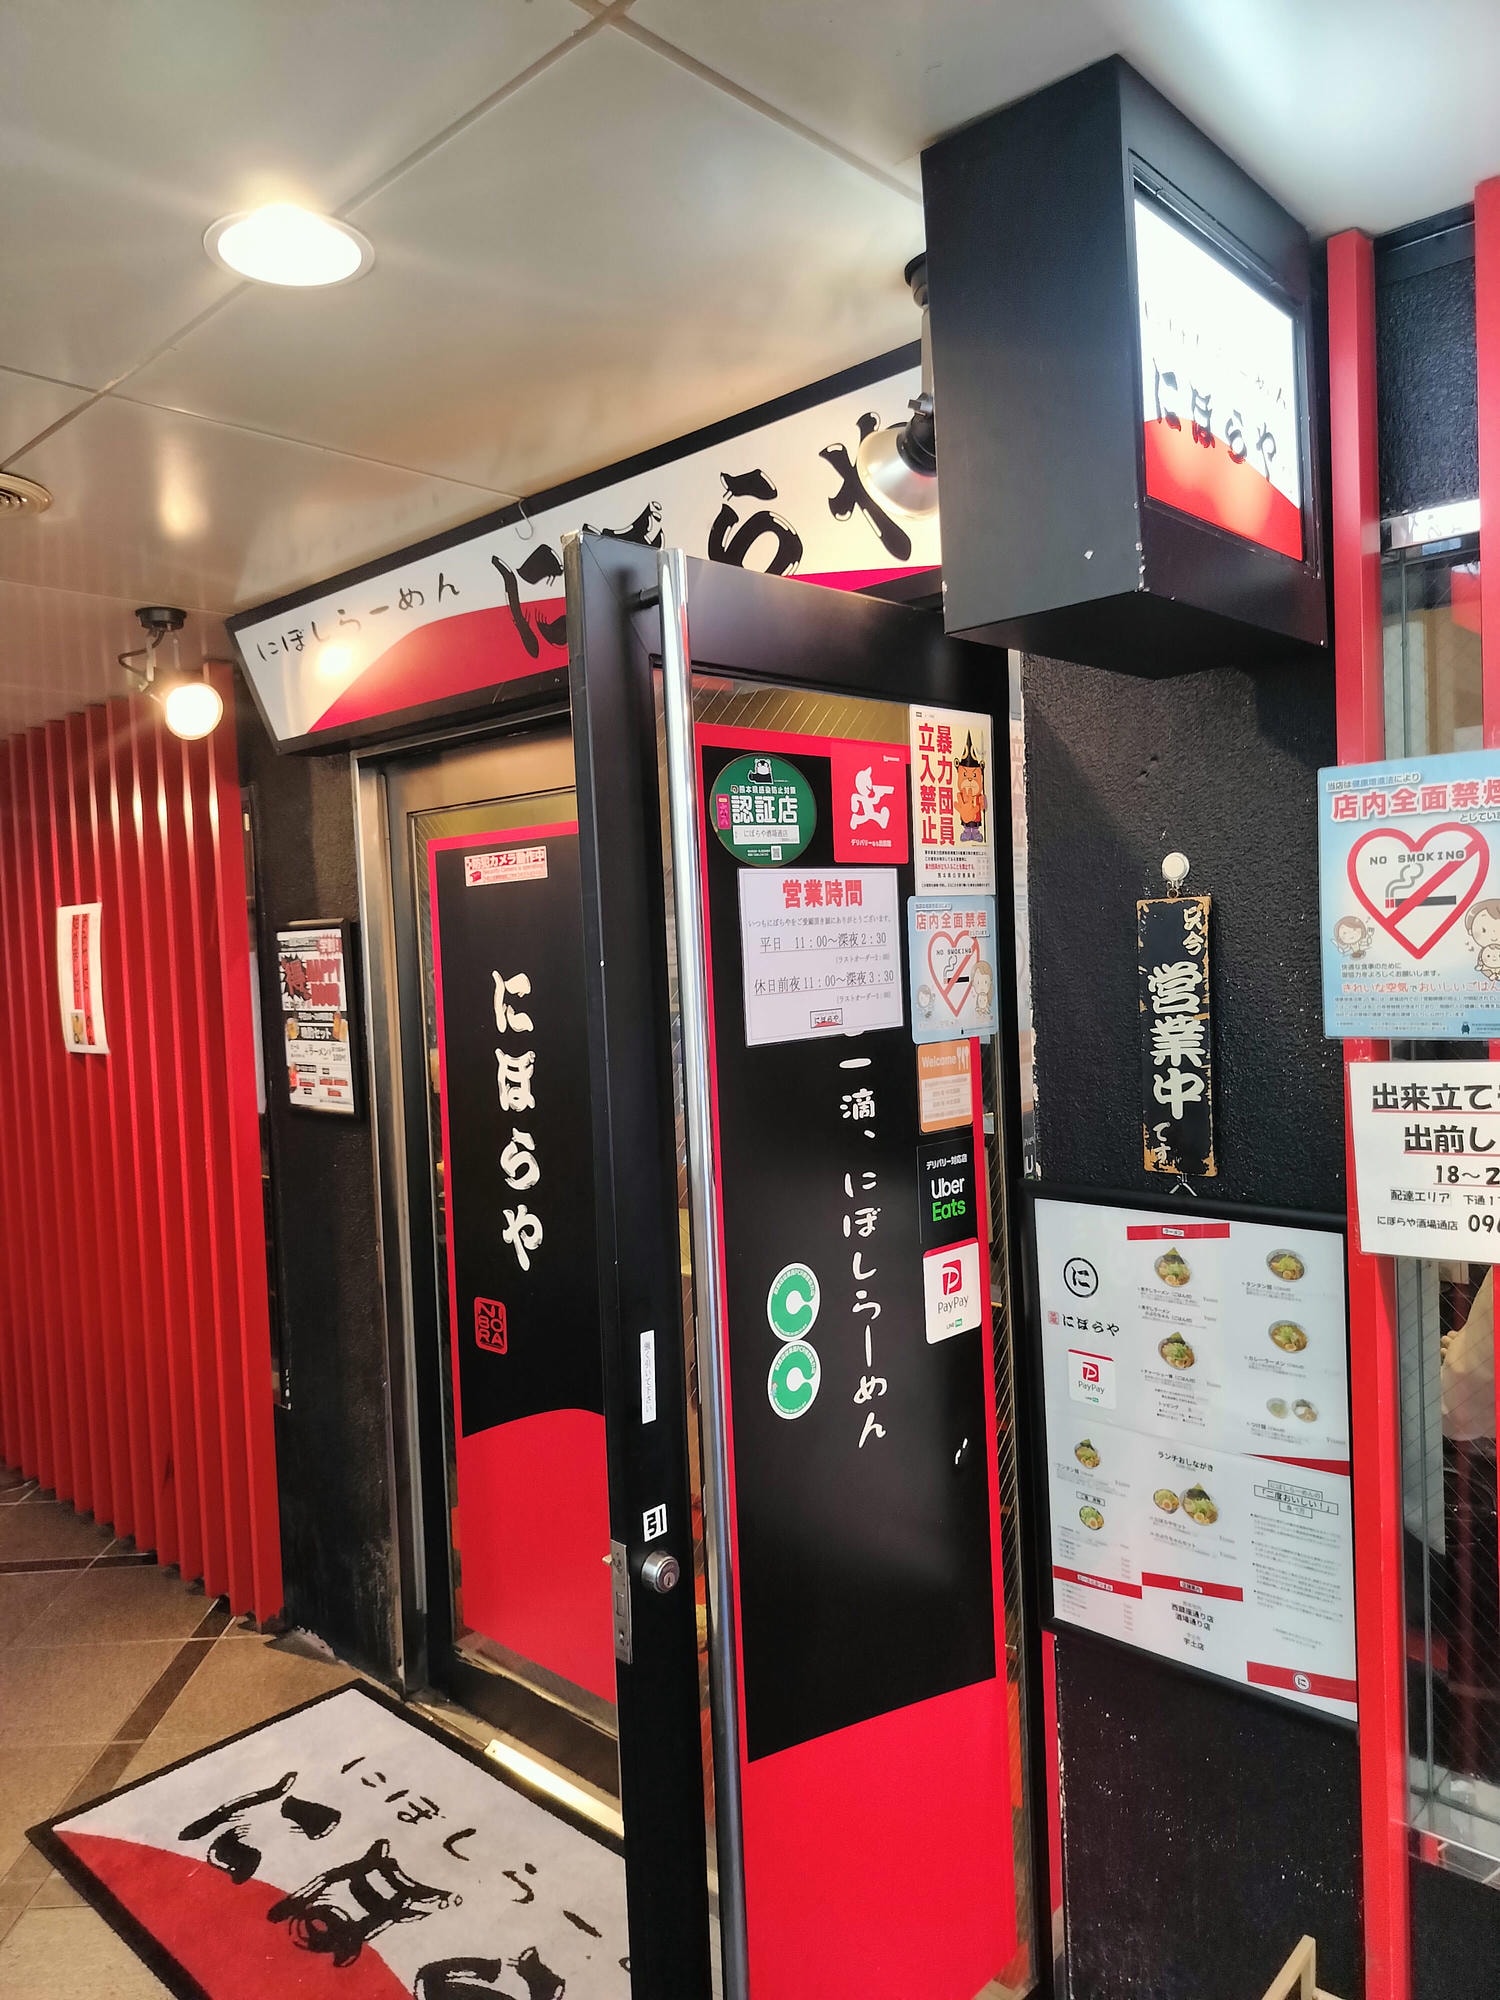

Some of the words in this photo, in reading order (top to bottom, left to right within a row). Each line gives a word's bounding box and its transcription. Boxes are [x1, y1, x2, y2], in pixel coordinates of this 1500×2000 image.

[256, 572, 460, 661] にぼしらーめん
[918, 723, 938, 845] 立入禁止
[937, 725, 956, 846] 暴力団員
[731, 795, 799, 824] 認証店
[1370, 857, 1387, 866] NO
[1398, 850, 1465, 863] SMOKING
[782, 878, 864, 909] 営業時間
[1183, 906, 1204, 956] 只今
[760, 936, 781, 953] 平日
[1148, 961, 1206, 1120] 営業中
[922, 1055, 957, 1068] Welcome
[1372, 1083, 1500, 1112] 出来立て
[1152, 1121, 1171, 1164] です
[931, 1177, 965, 1199] Uber
[1390, 1189, 1450, 1203] 配達エリア
[932, 1199, 966, 1222] Eats
[1377, 1215, 1458, 1231] にぼらや酒場通店
[1468, 1214, 1500, 1233] 09
[937, 1296, 969, 1314] PayPay
[1078, 1381, 1105, 1395] PayPay
[1158, 1451, 1214, 1472] ランチおしながき
